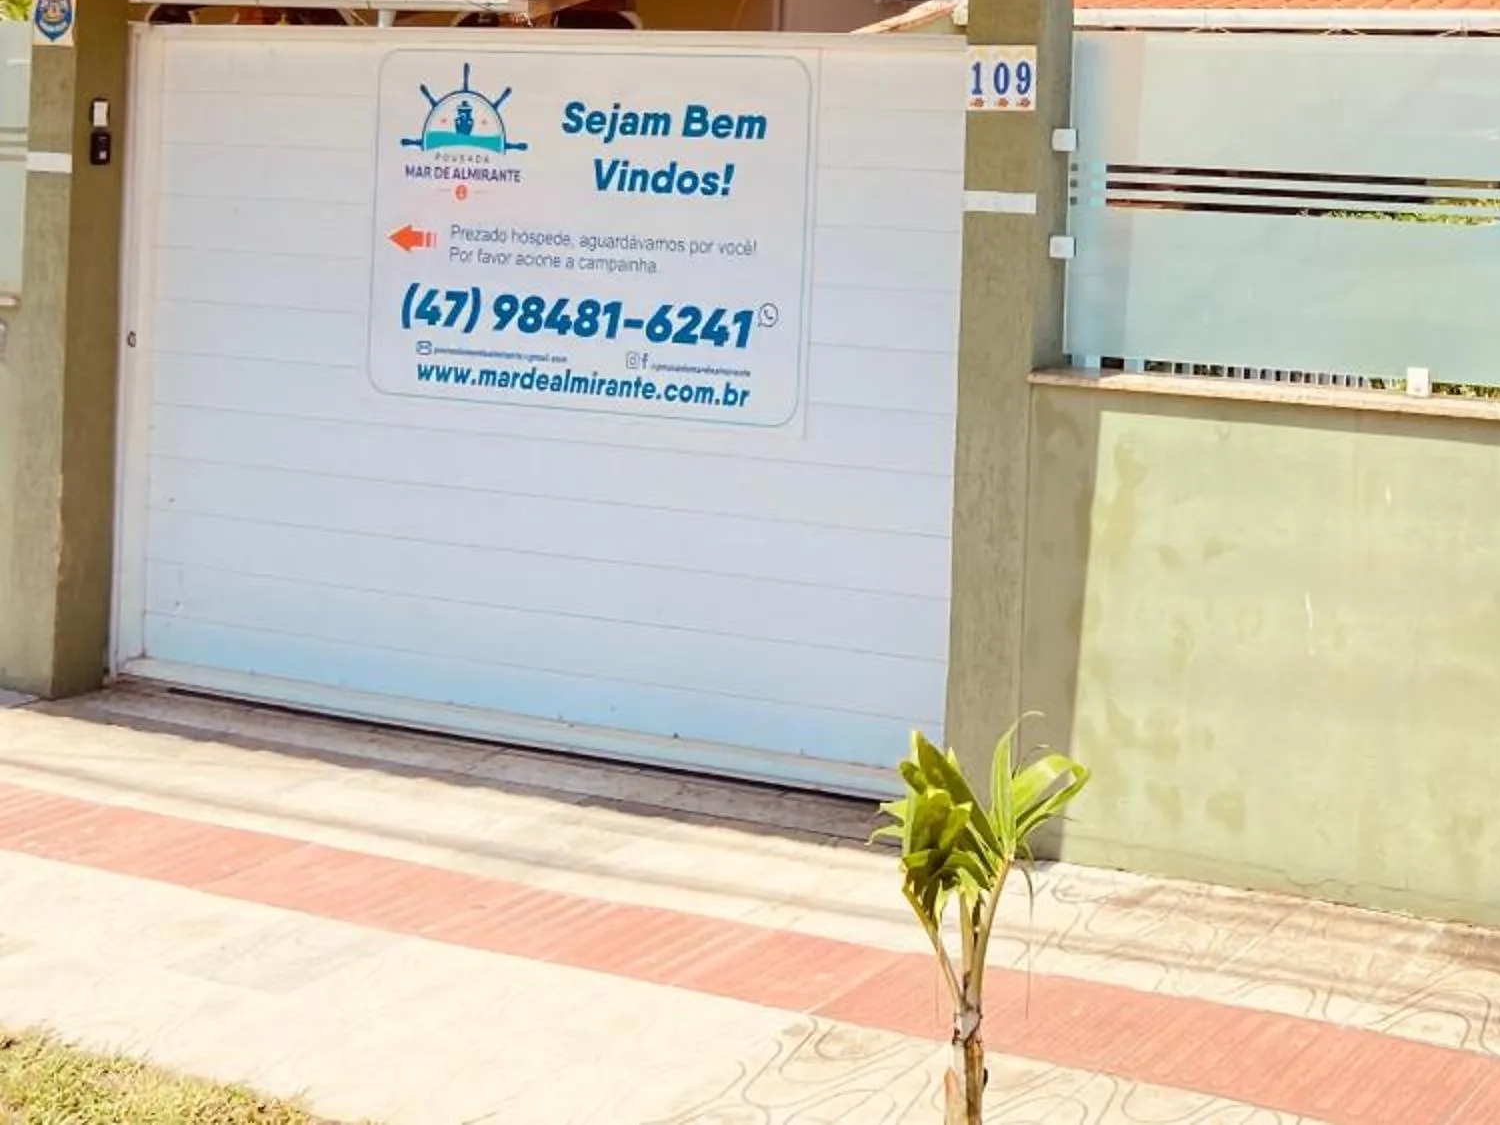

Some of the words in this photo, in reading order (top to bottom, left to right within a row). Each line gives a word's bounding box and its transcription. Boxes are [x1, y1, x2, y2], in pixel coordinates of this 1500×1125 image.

[971, 61, 1031, 95] 109
[562, 101, 671, 143] Sejam
[682, 105, 767, 139] Bem
[405, 165, 430, 179] MAR
[435, 167, 450, 179] DE
[452, 167, 520, 183] ALMIRANTE
[594, 159, 735, 195] Vindos!
[451, 224, 507, 243] Prezado
[690, 240, 715, 254] por
[450, 246, 473, 263] Por
[477, 248, 511, 265] favor
[515, 254, 561, 267] acione
[566, 258, 574, 269] a
[401, 283, 481, 334] (47)
[492, 294, 755, 348] 98481-6241
[417, 363, 750, 407] www.mardealmirante.com.br
